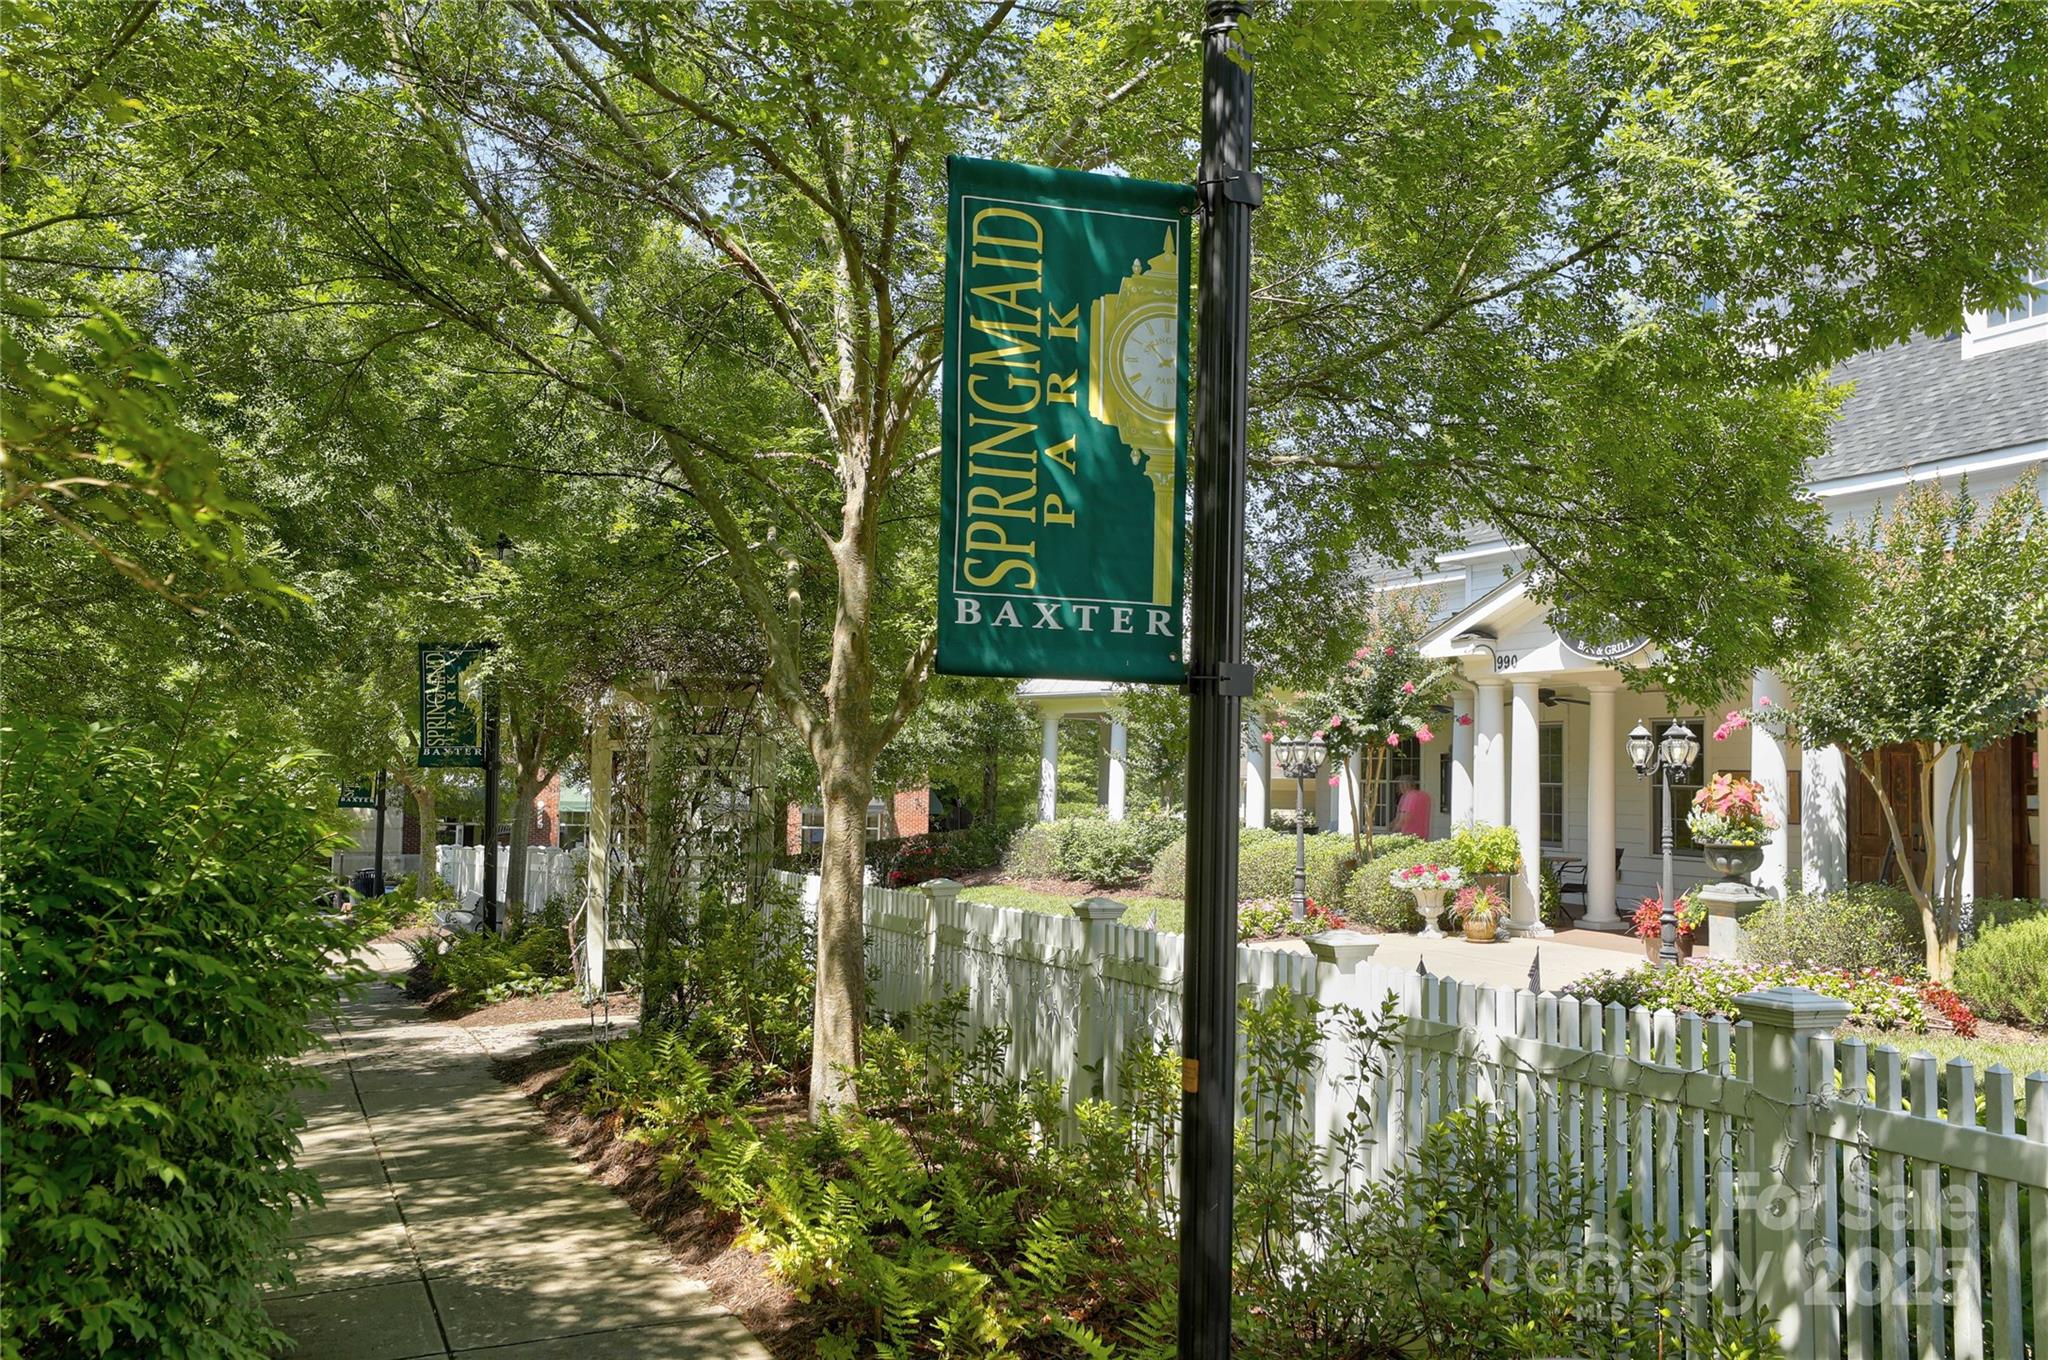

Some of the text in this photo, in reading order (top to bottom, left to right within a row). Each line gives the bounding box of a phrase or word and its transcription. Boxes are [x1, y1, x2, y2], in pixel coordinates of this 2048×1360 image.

[963, 207, 1043, 590] SPRINGMAID
[1043, 301, 1080, 528] PARK
[954, 598, 1174, 637] BAXTER
[1497, 654, 1518, 669] 990
[1596, 647, 1603, 655] &
[1604, 640, 1634, 655] GRILL
[446, 674, 457, 730] PARK
